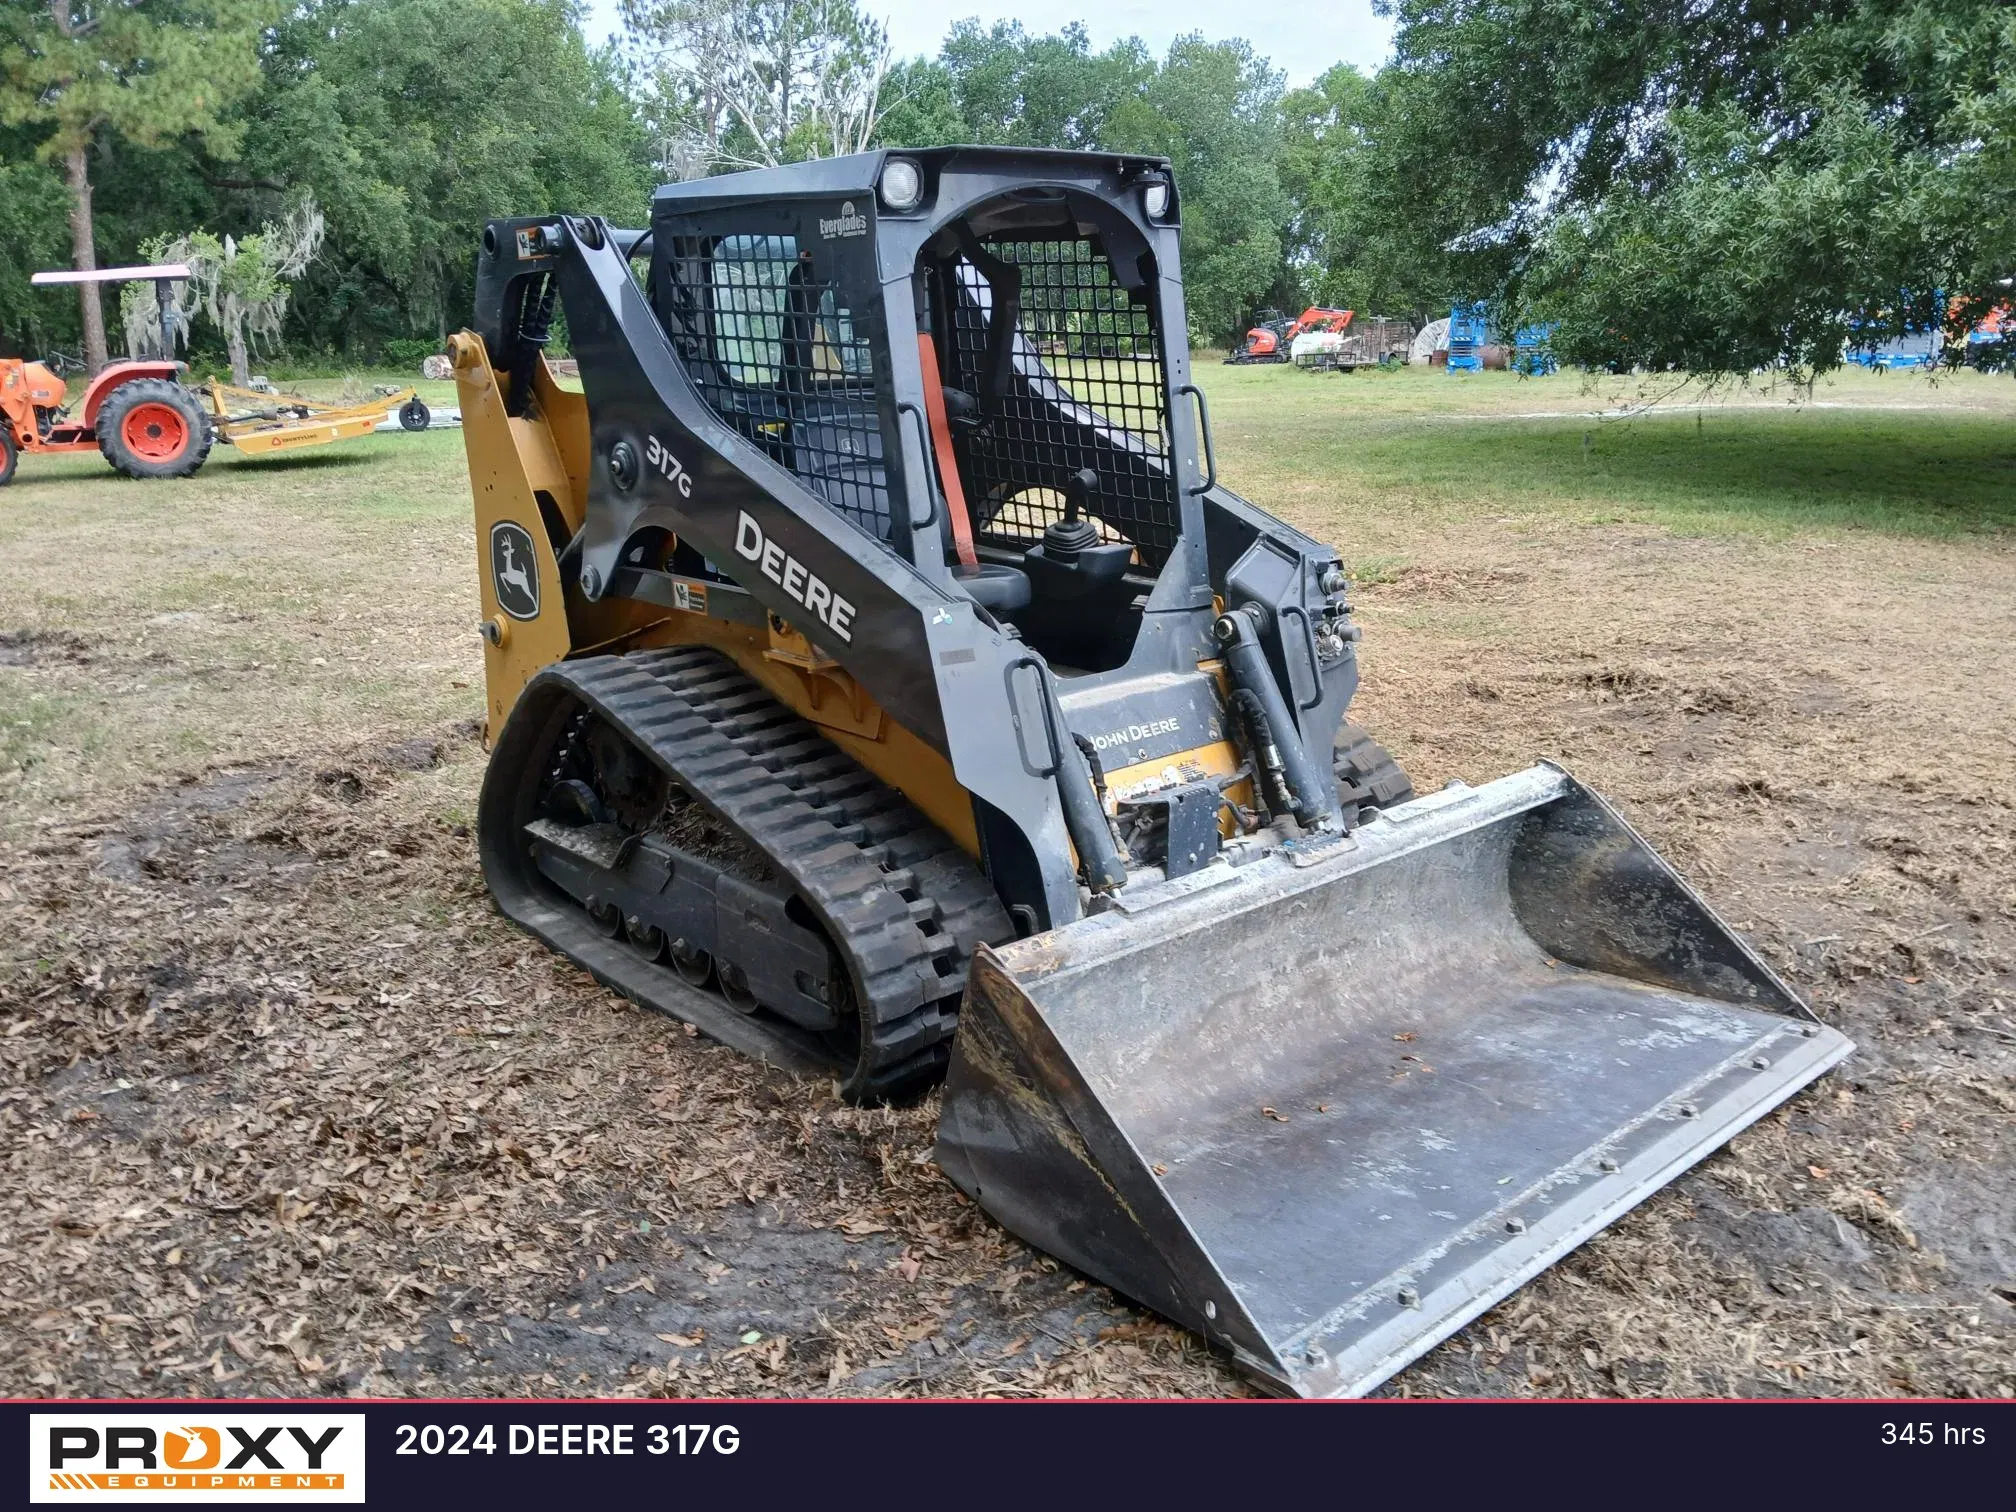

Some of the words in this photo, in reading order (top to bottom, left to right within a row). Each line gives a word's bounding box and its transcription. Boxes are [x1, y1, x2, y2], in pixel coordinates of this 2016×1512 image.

[819, 214, 867, 236] Everglades
[646, 434, 692, 498] 317G
[735, 509, 856, 642] DEERE
[1128, 718, 1180, 741] DEERE
